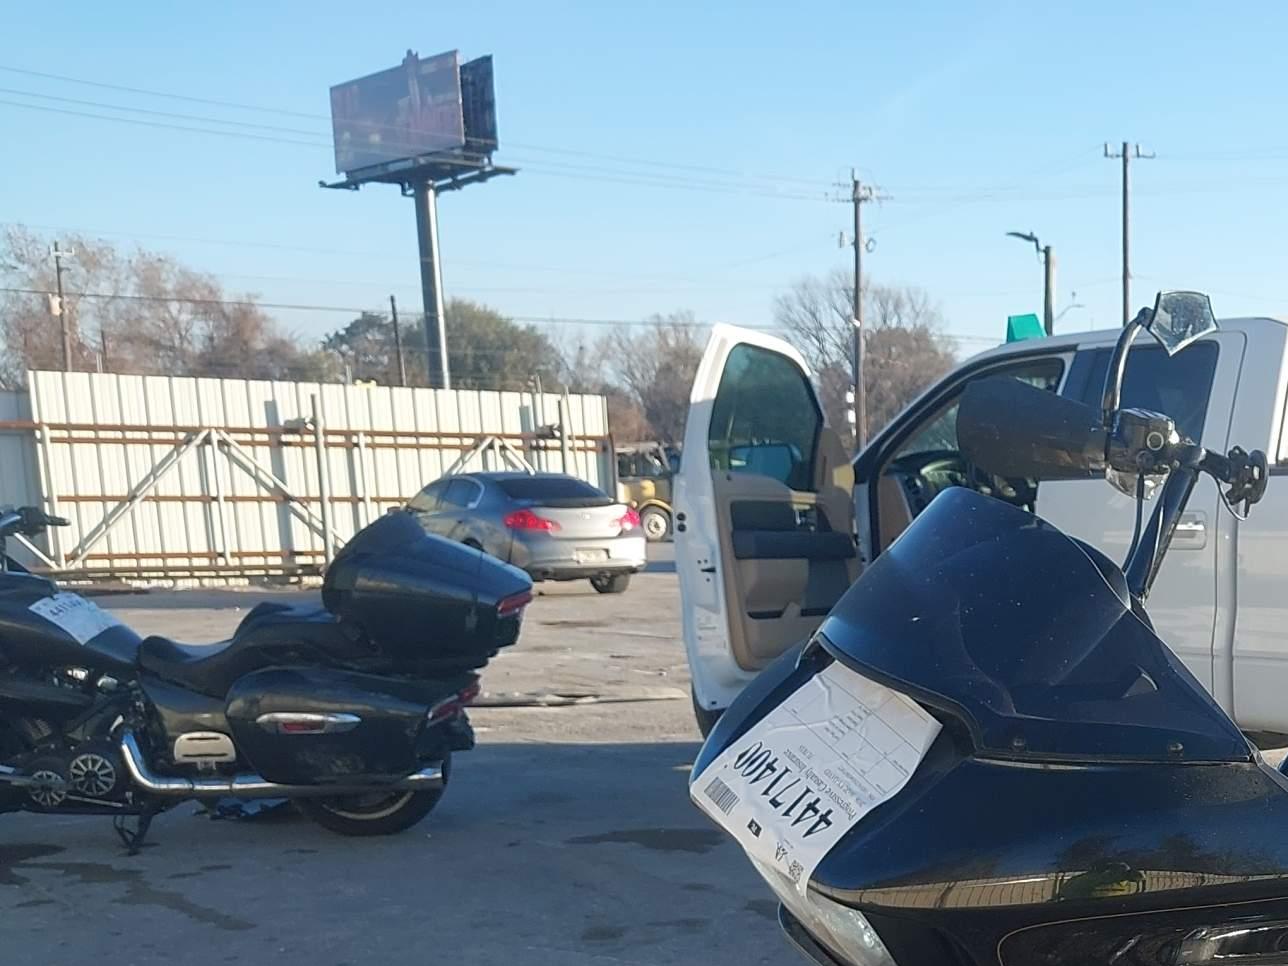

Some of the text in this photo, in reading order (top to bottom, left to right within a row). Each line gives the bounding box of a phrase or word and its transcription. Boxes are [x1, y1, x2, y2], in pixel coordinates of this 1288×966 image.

[783, 748, 807, 774] Insurance
[733, 741, 833, 838] 44171400
[803, 766, 828, 794] Casualty
